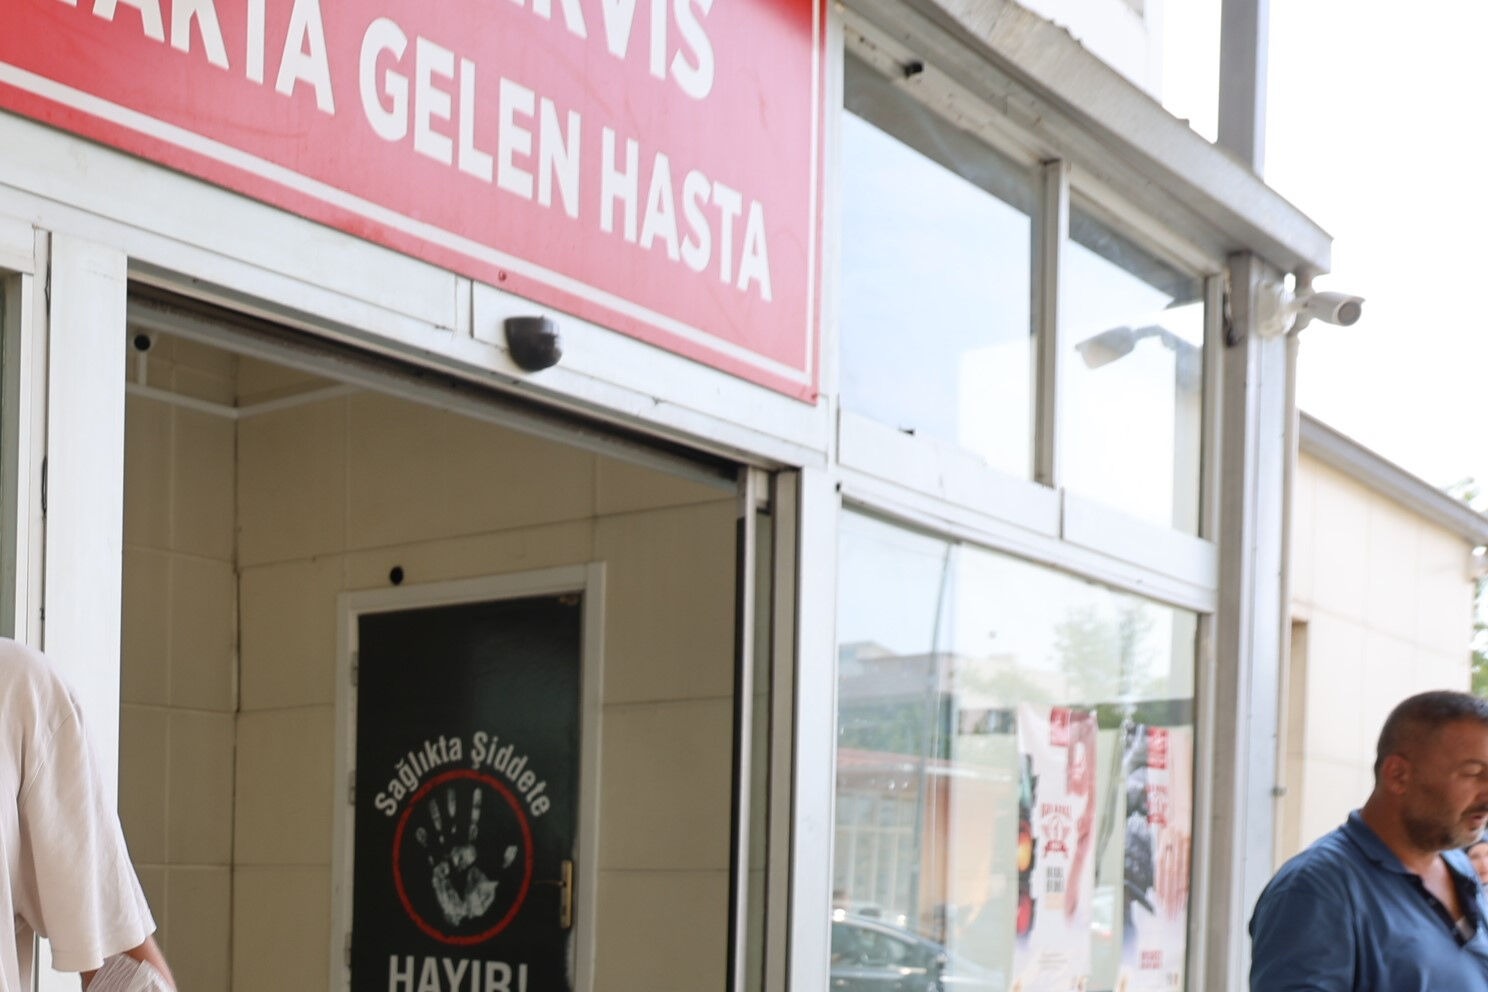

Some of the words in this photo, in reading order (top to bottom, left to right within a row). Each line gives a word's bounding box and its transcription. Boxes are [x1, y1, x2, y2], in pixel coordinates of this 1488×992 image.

[359, 17, 582, 219] GELEN
[600, 126, 772, 302] HASTA
[374, 734, 463, 817] Sağlıkta
[470, 731, 551, 817] Şiddete
